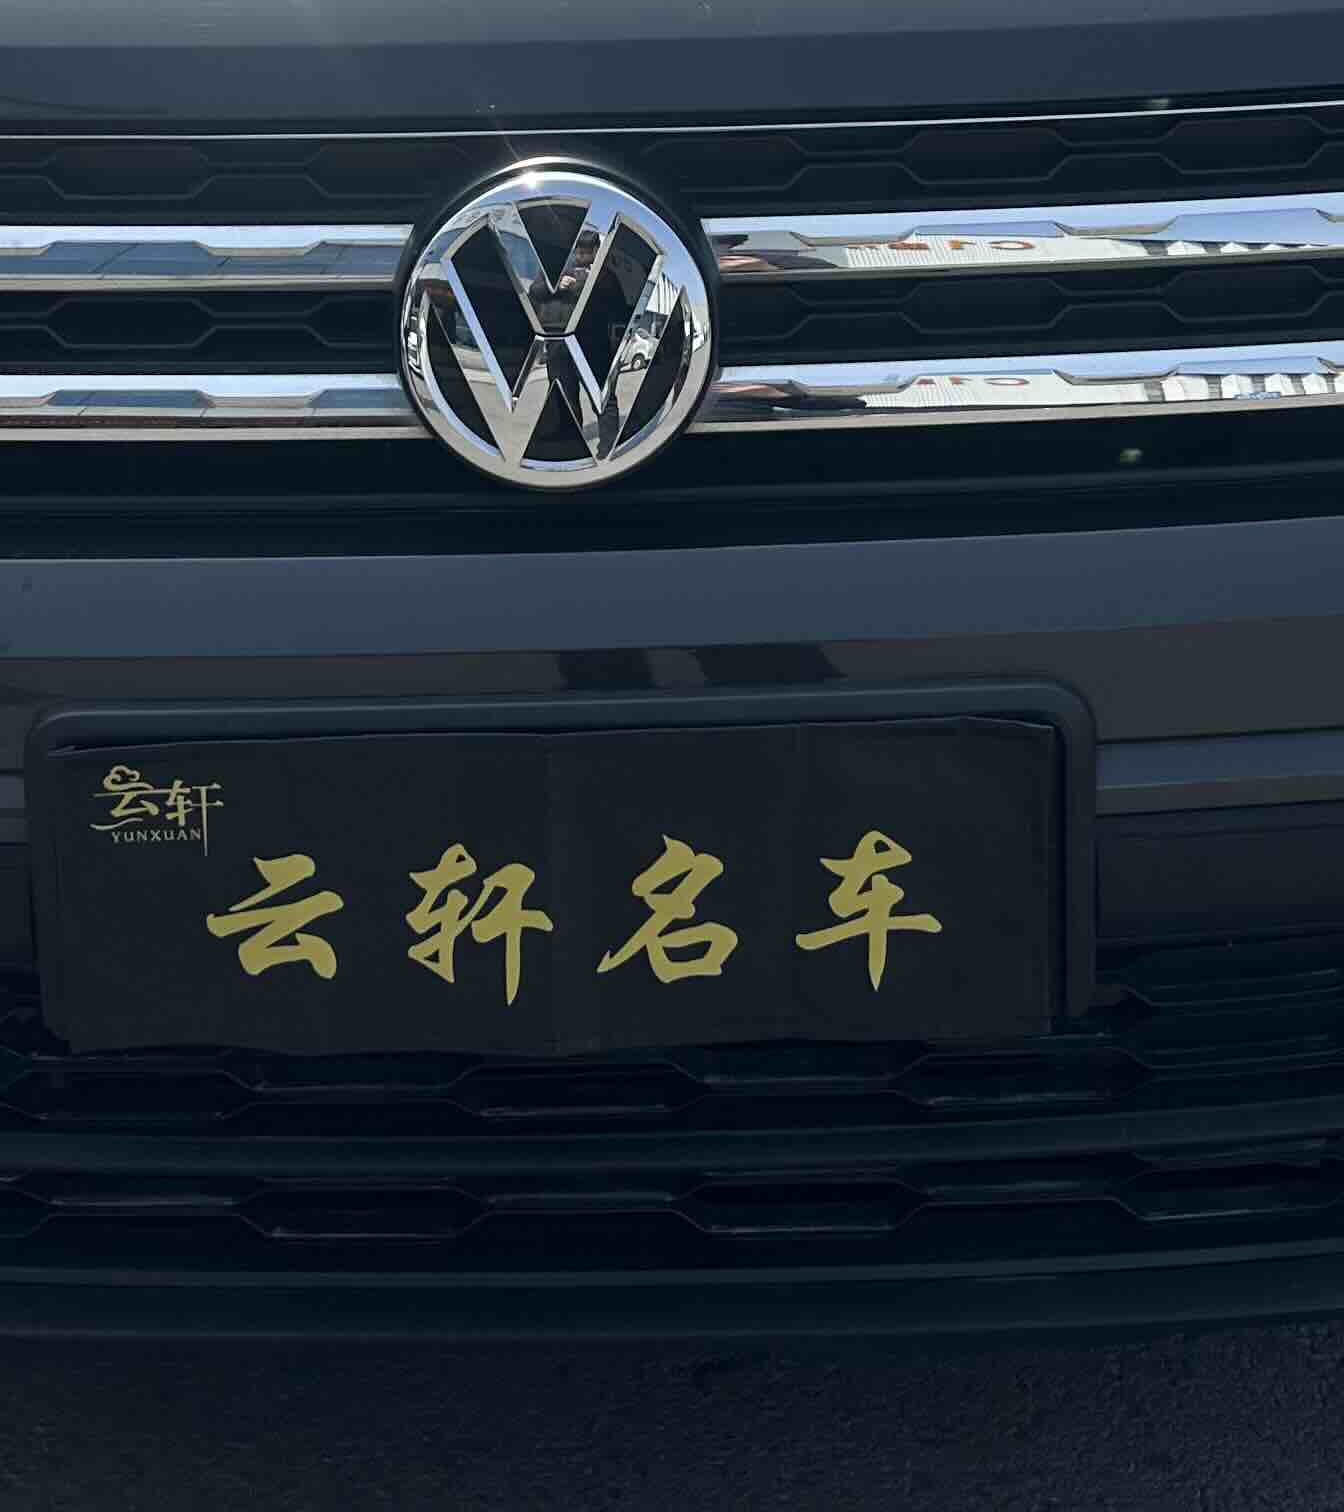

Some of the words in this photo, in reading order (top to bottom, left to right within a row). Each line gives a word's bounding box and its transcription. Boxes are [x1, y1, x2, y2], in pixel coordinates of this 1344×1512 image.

[90, 765, 224, 857] 云轩
[111, 829, 202, 843] YUNXUAN
[206, 830, 942, 1005] 云轩名车
